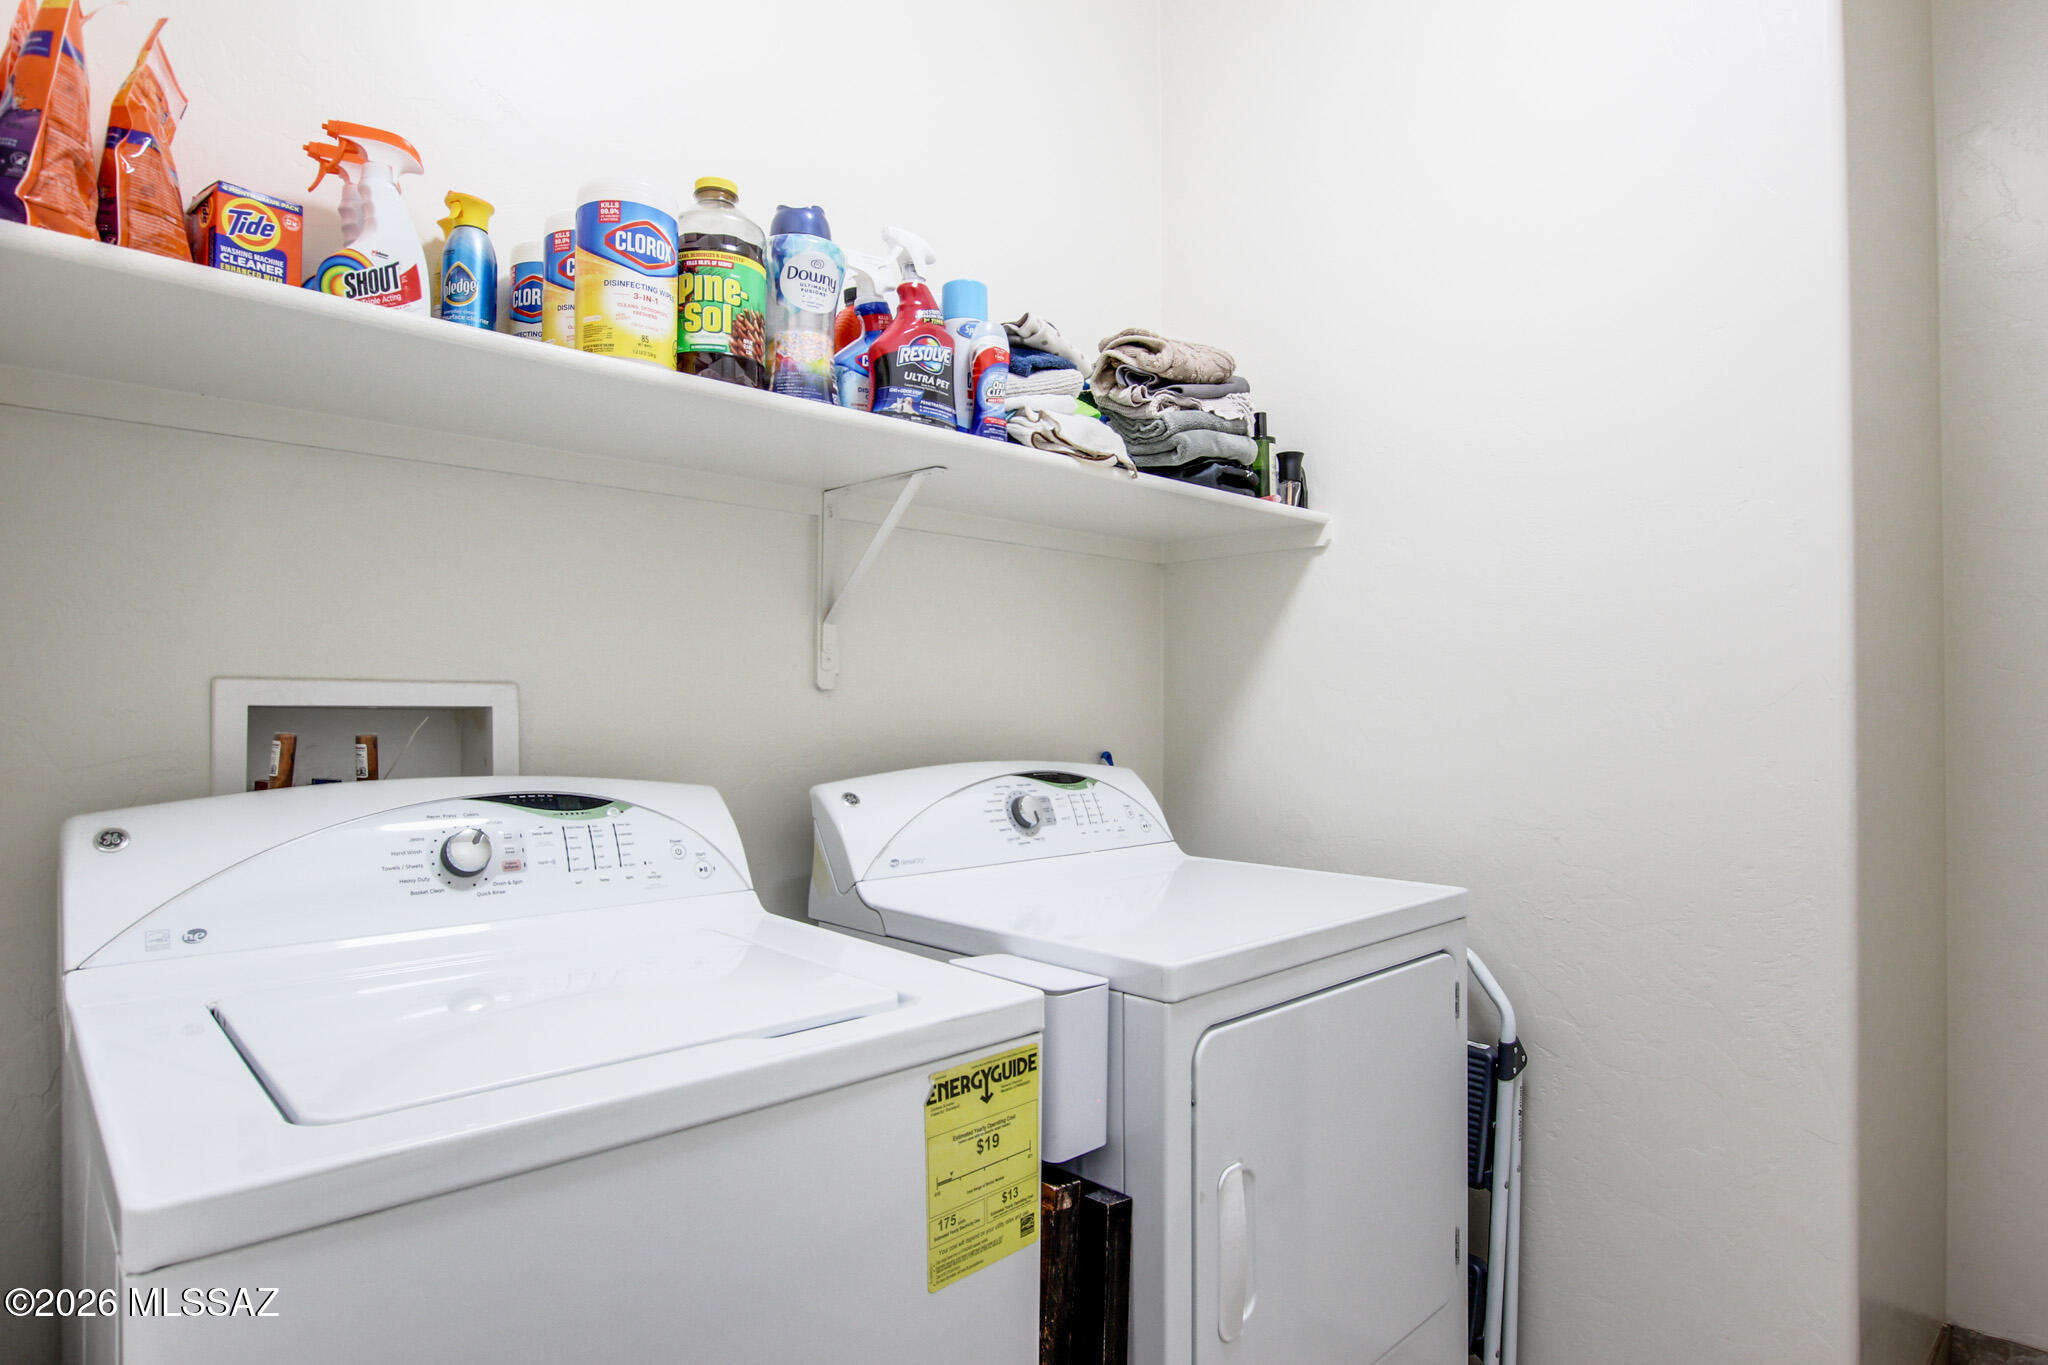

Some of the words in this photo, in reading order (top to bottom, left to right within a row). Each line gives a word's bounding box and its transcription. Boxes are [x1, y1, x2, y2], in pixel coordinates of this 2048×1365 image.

[281, 202, 300, 212] PACK
[227, 208, 276, 238] Tide
[220, 245, 253, 259] WASHING
[254, 252, 284, 268] MACHINE
[615, 230, 672, 264] CLOROX
[220, 252, 284, 276] CLEANER
[220, 263, 262, 279] ENHANCED
[344, 262, 400, 299] SHOUT
[604, 280, 658, 294] DISINFECTING
[786, 265, 837, 294] Downy
[800, 282, 828, 293] ULTIMATE
[382, 294, 402, 303] Acting
[633, 292, 659, 305] 3-IN-1
[678, 272, 749, 307] Pine-
[684, 302, 732, 334] Sol
[641, 334, 650, 343] 85
[900, 346, 952, 364] RESOLVE
[904, 371, 935, 386] ULTRA
[936, 379, 950, 390] PET
[952, 1130, 974, 1142] Estimated
[974, 1126, 986, 1134] Yearly
[987, 1118, 1006, 1129] Operating
[976, 1133, 1000, 1156] $19
[1002, 1186, 1018, 1204] $13
[938, 1214, 956, 1231] 175
